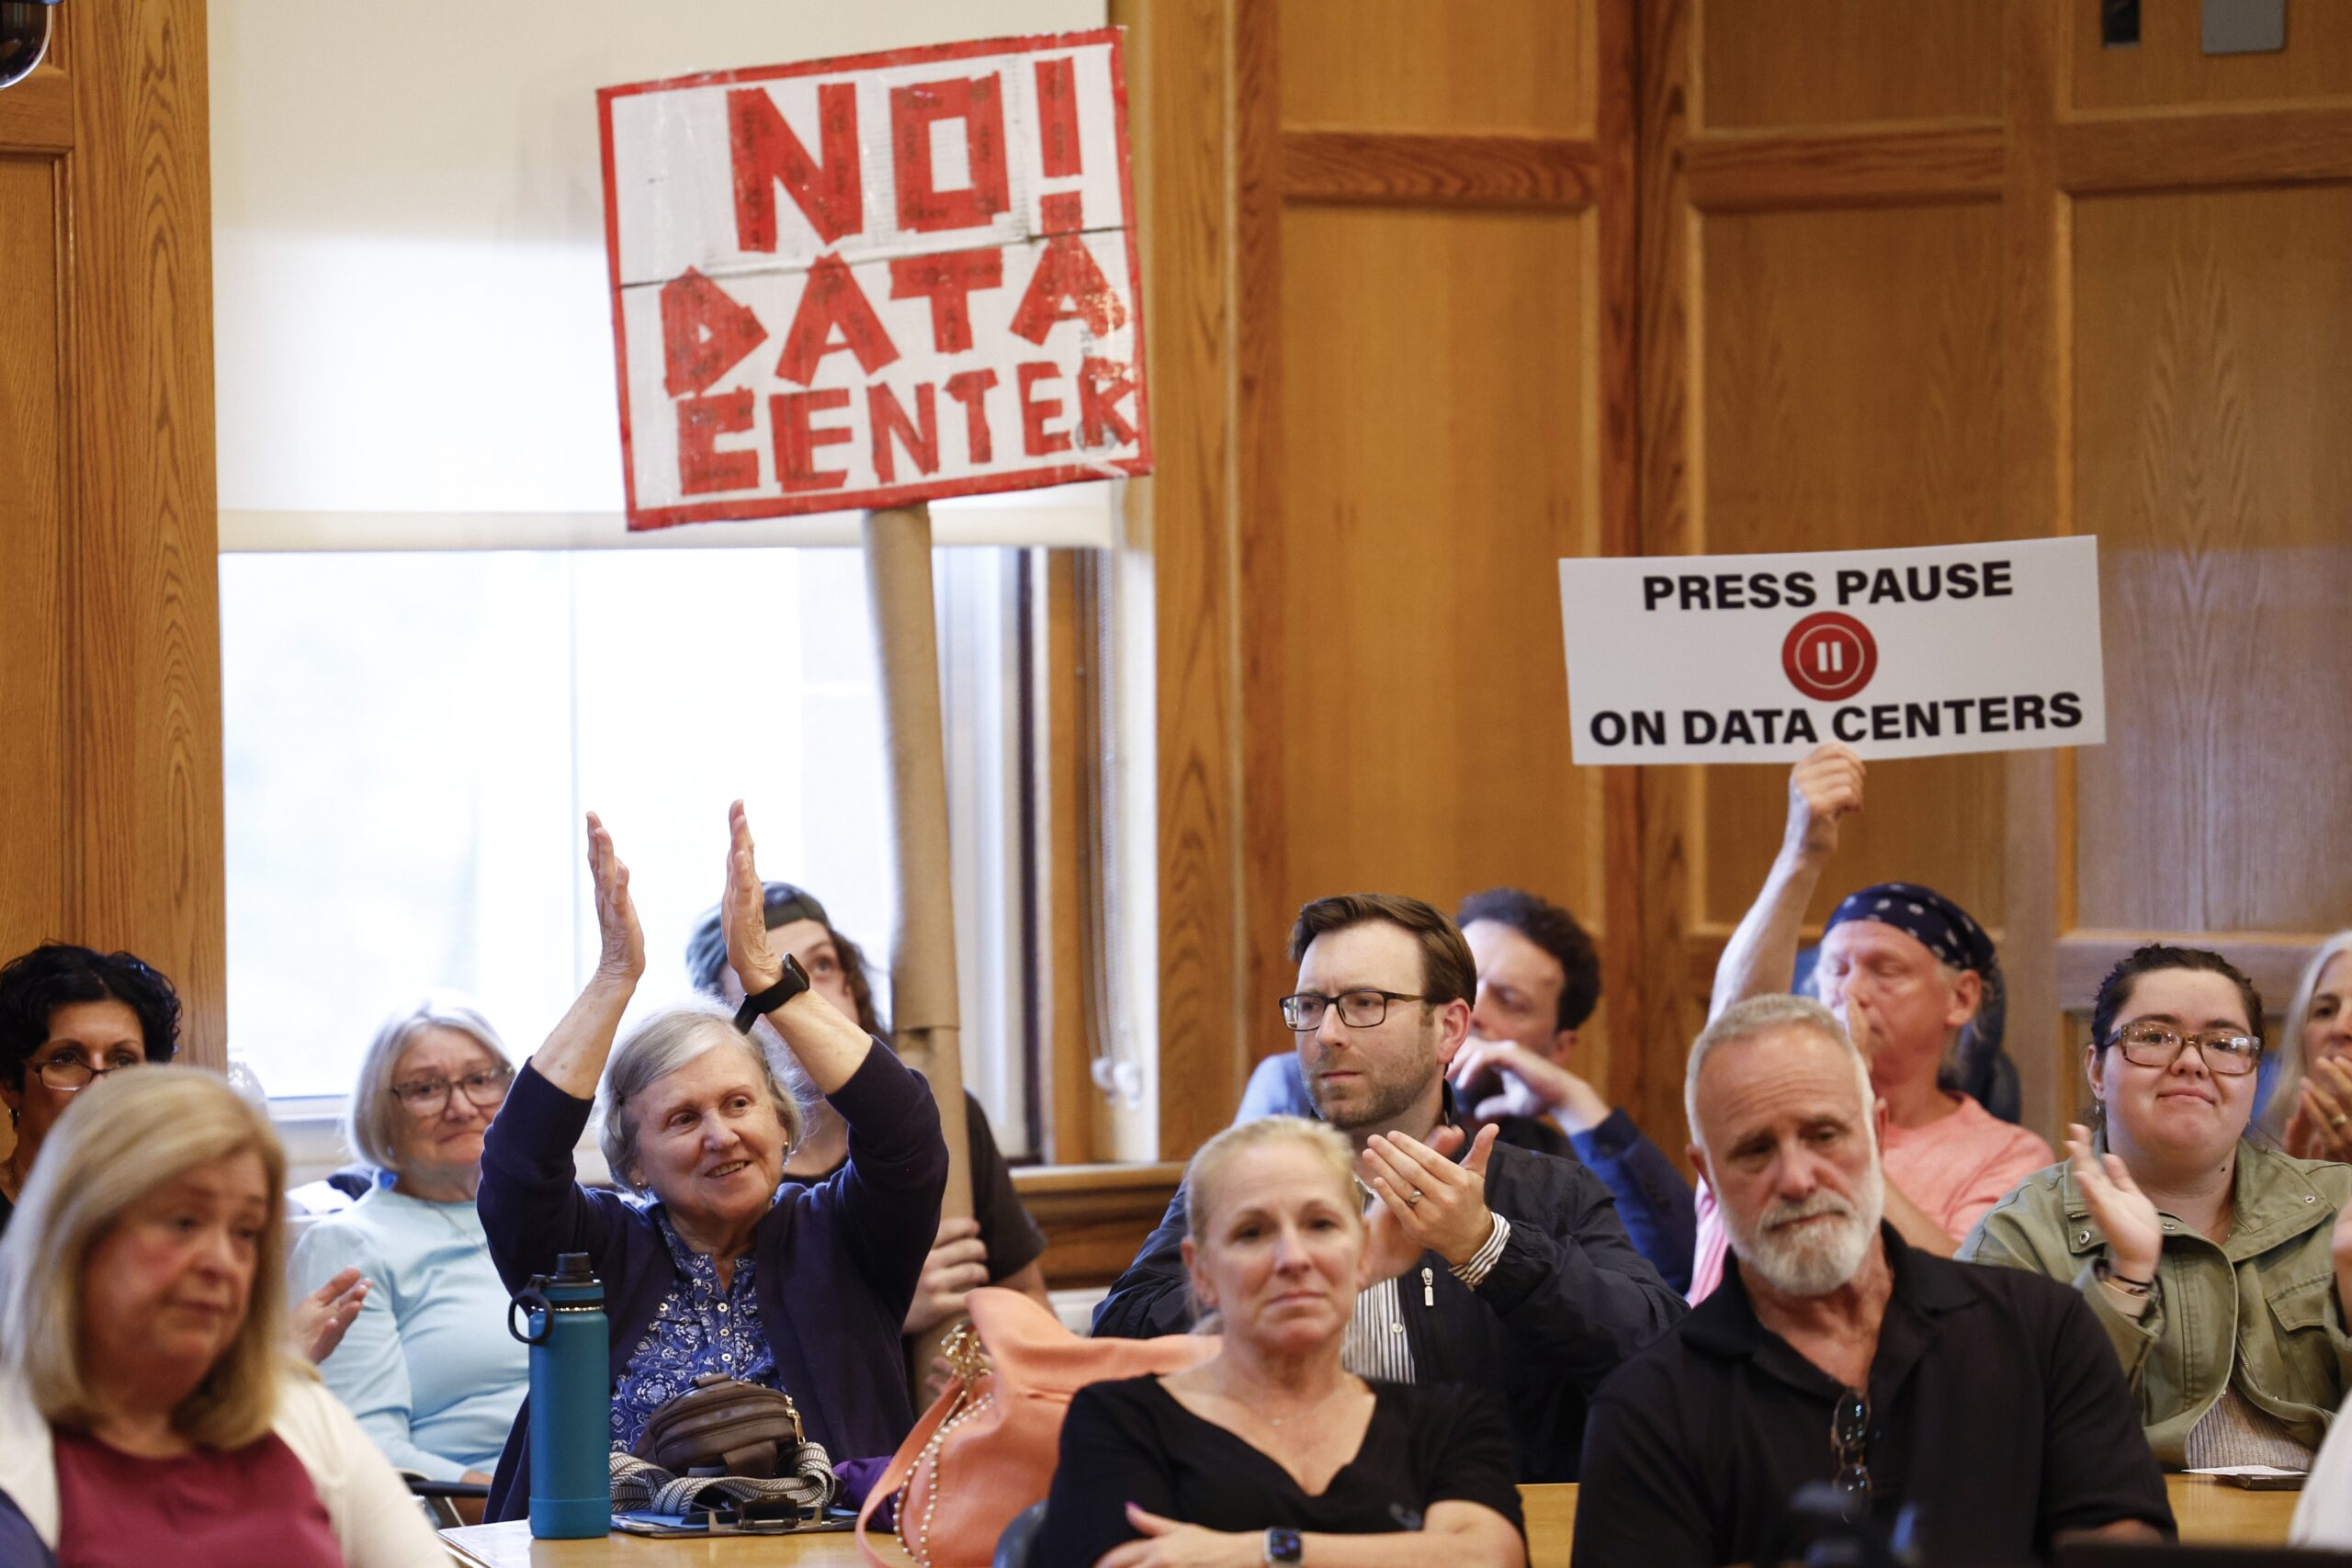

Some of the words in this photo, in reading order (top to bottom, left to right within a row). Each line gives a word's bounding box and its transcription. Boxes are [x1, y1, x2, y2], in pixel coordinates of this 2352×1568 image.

[727, 56, 1083, 254] NO!
[660, 234, 1126, 400] DATA
[676, 356, 1138, 496] CENTER
[1643, 571, 1816, 611] PRESS
[1837, 560, 2013, 606] PAUSE
[1590, 710, 1666, 746] ON
[1682, 709, 1818, 745] DATA
[1832, 692, 2083, 742] CENTERS
